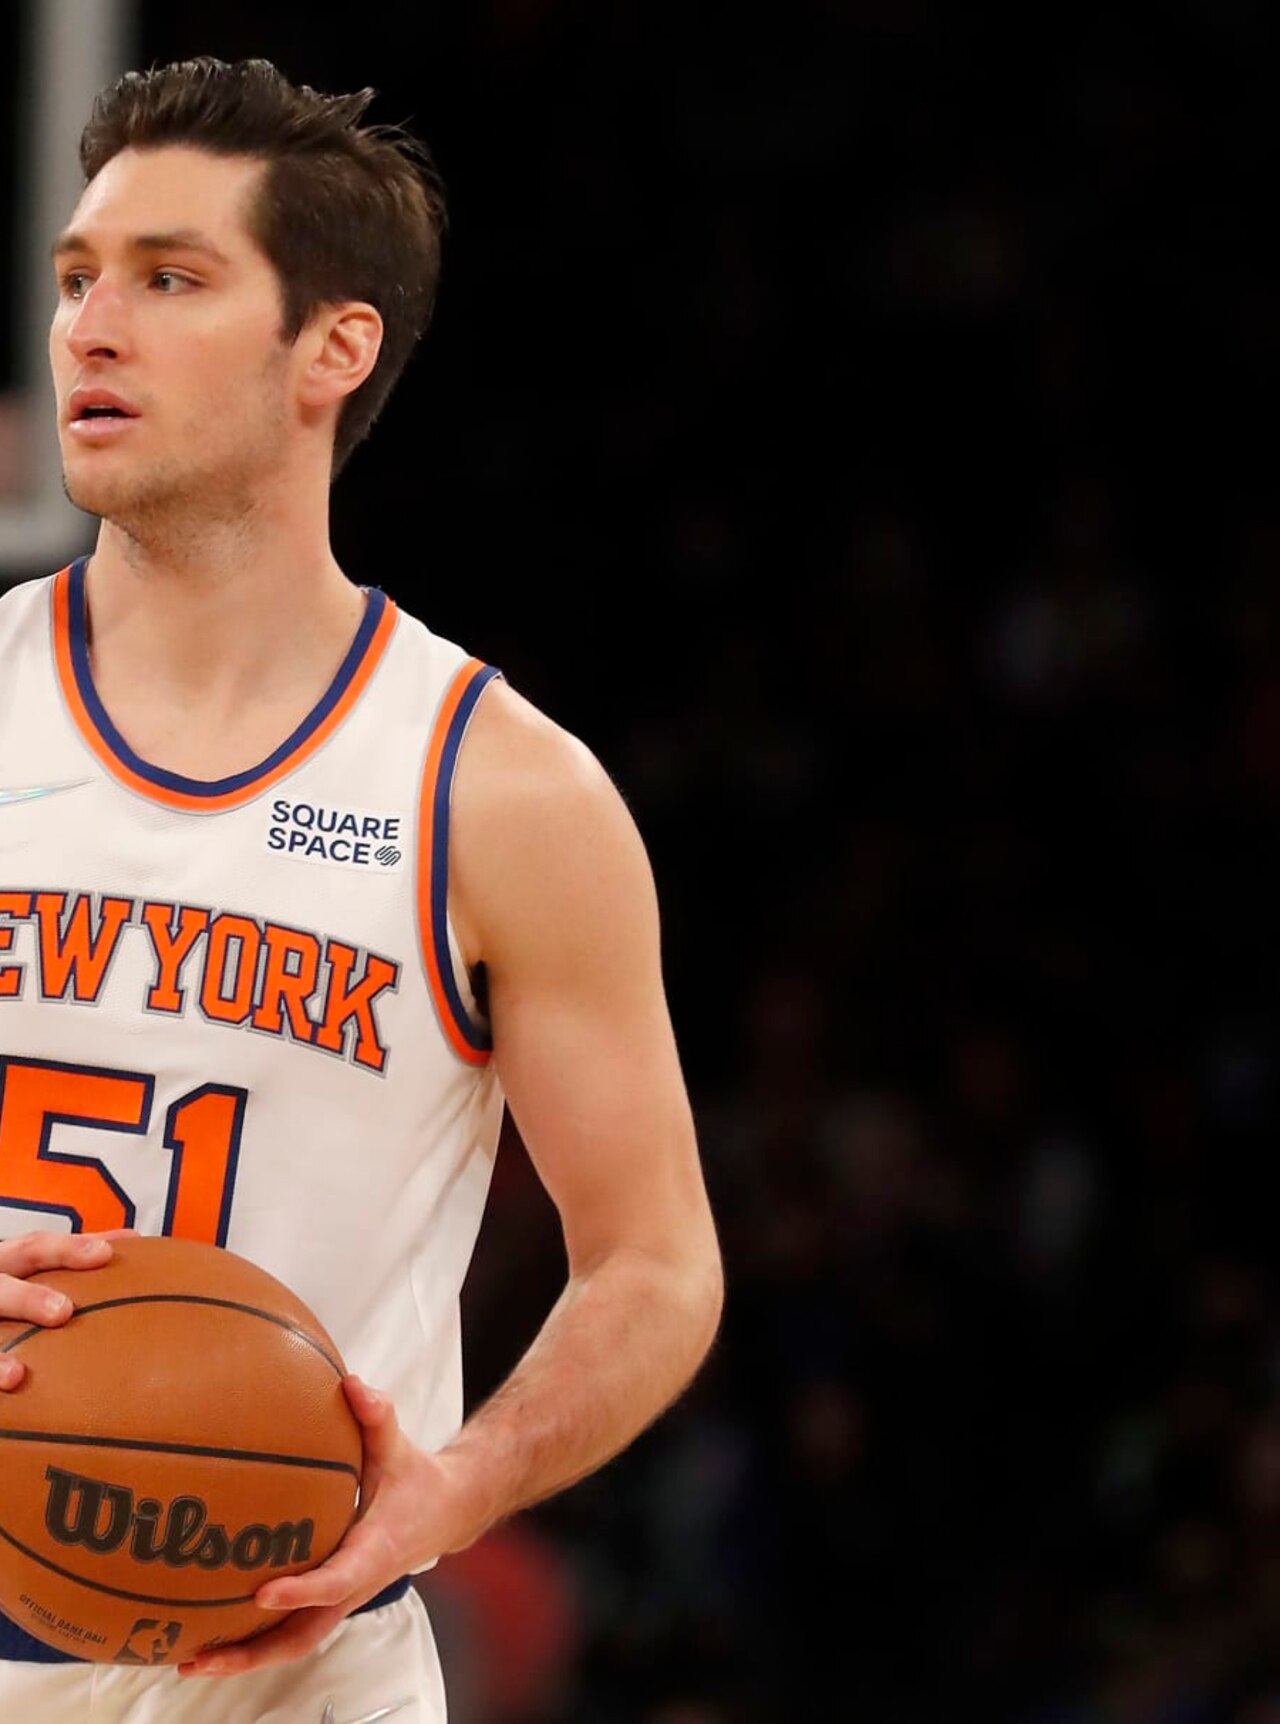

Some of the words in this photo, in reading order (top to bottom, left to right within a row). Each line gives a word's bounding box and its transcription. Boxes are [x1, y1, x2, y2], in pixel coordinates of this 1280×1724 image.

[267, 827, 371, 865] SPACE
[271, 800, 401, 840] SQUARE
[140, 899, 404, 1079] YORK
[44, 1464, 315, 1571] Wilson
